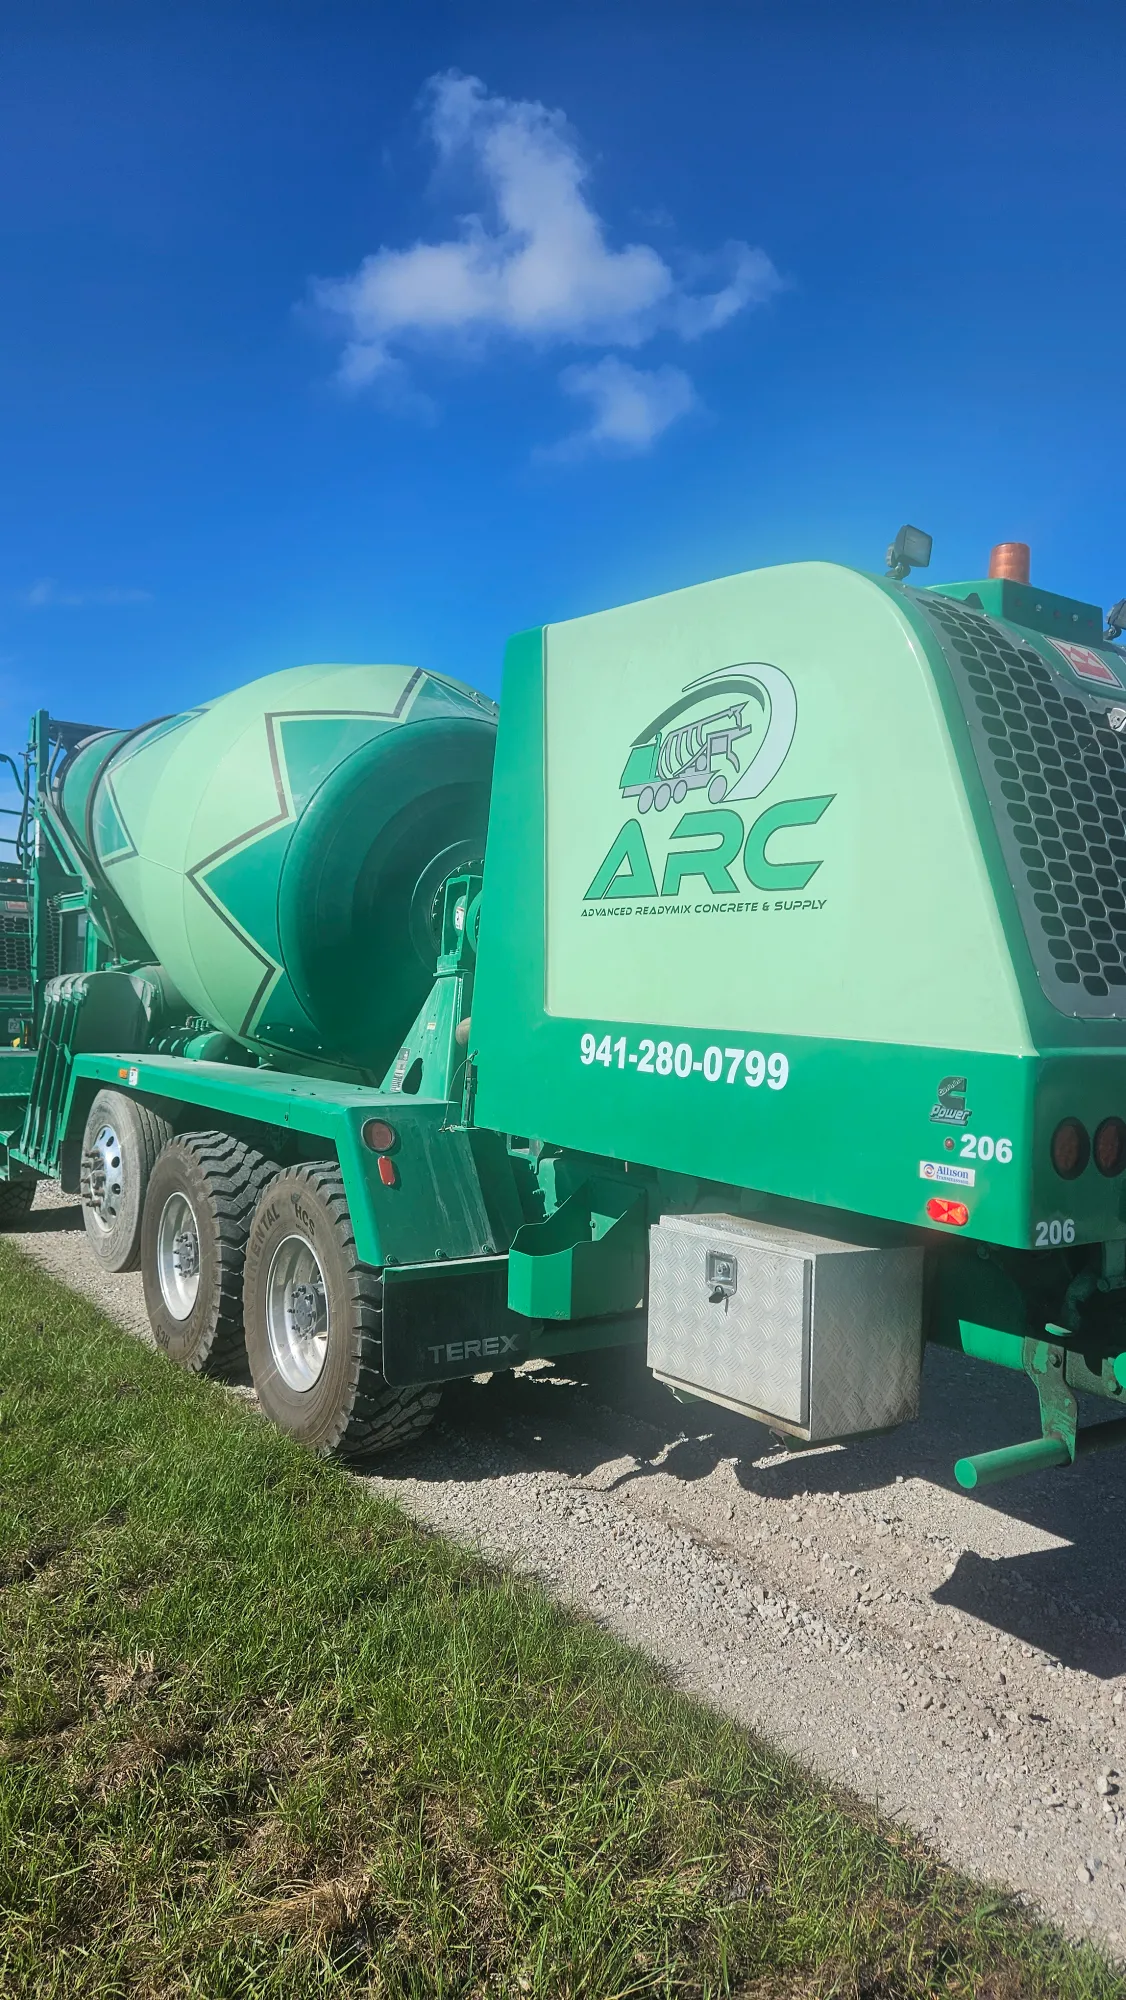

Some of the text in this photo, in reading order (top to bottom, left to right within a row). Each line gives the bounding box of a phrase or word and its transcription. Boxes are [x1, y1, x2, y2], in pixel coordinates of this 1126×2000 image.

[582, 793, 838, 901] ARC
[581, 899, 828, 917] ADVANCED READYMIX CONCRETE & SUPPLY
[580, 1033, 789, 1091] 941-280-0799
[930, 1104, 971, 1121] Power
[959, 1133, 1013, 1164] 206
[937, 1165, 969, 1180] Allison
[1035, 1219, 1076, 1247] 206
[427, 1333, 519, 1364] TEREX
